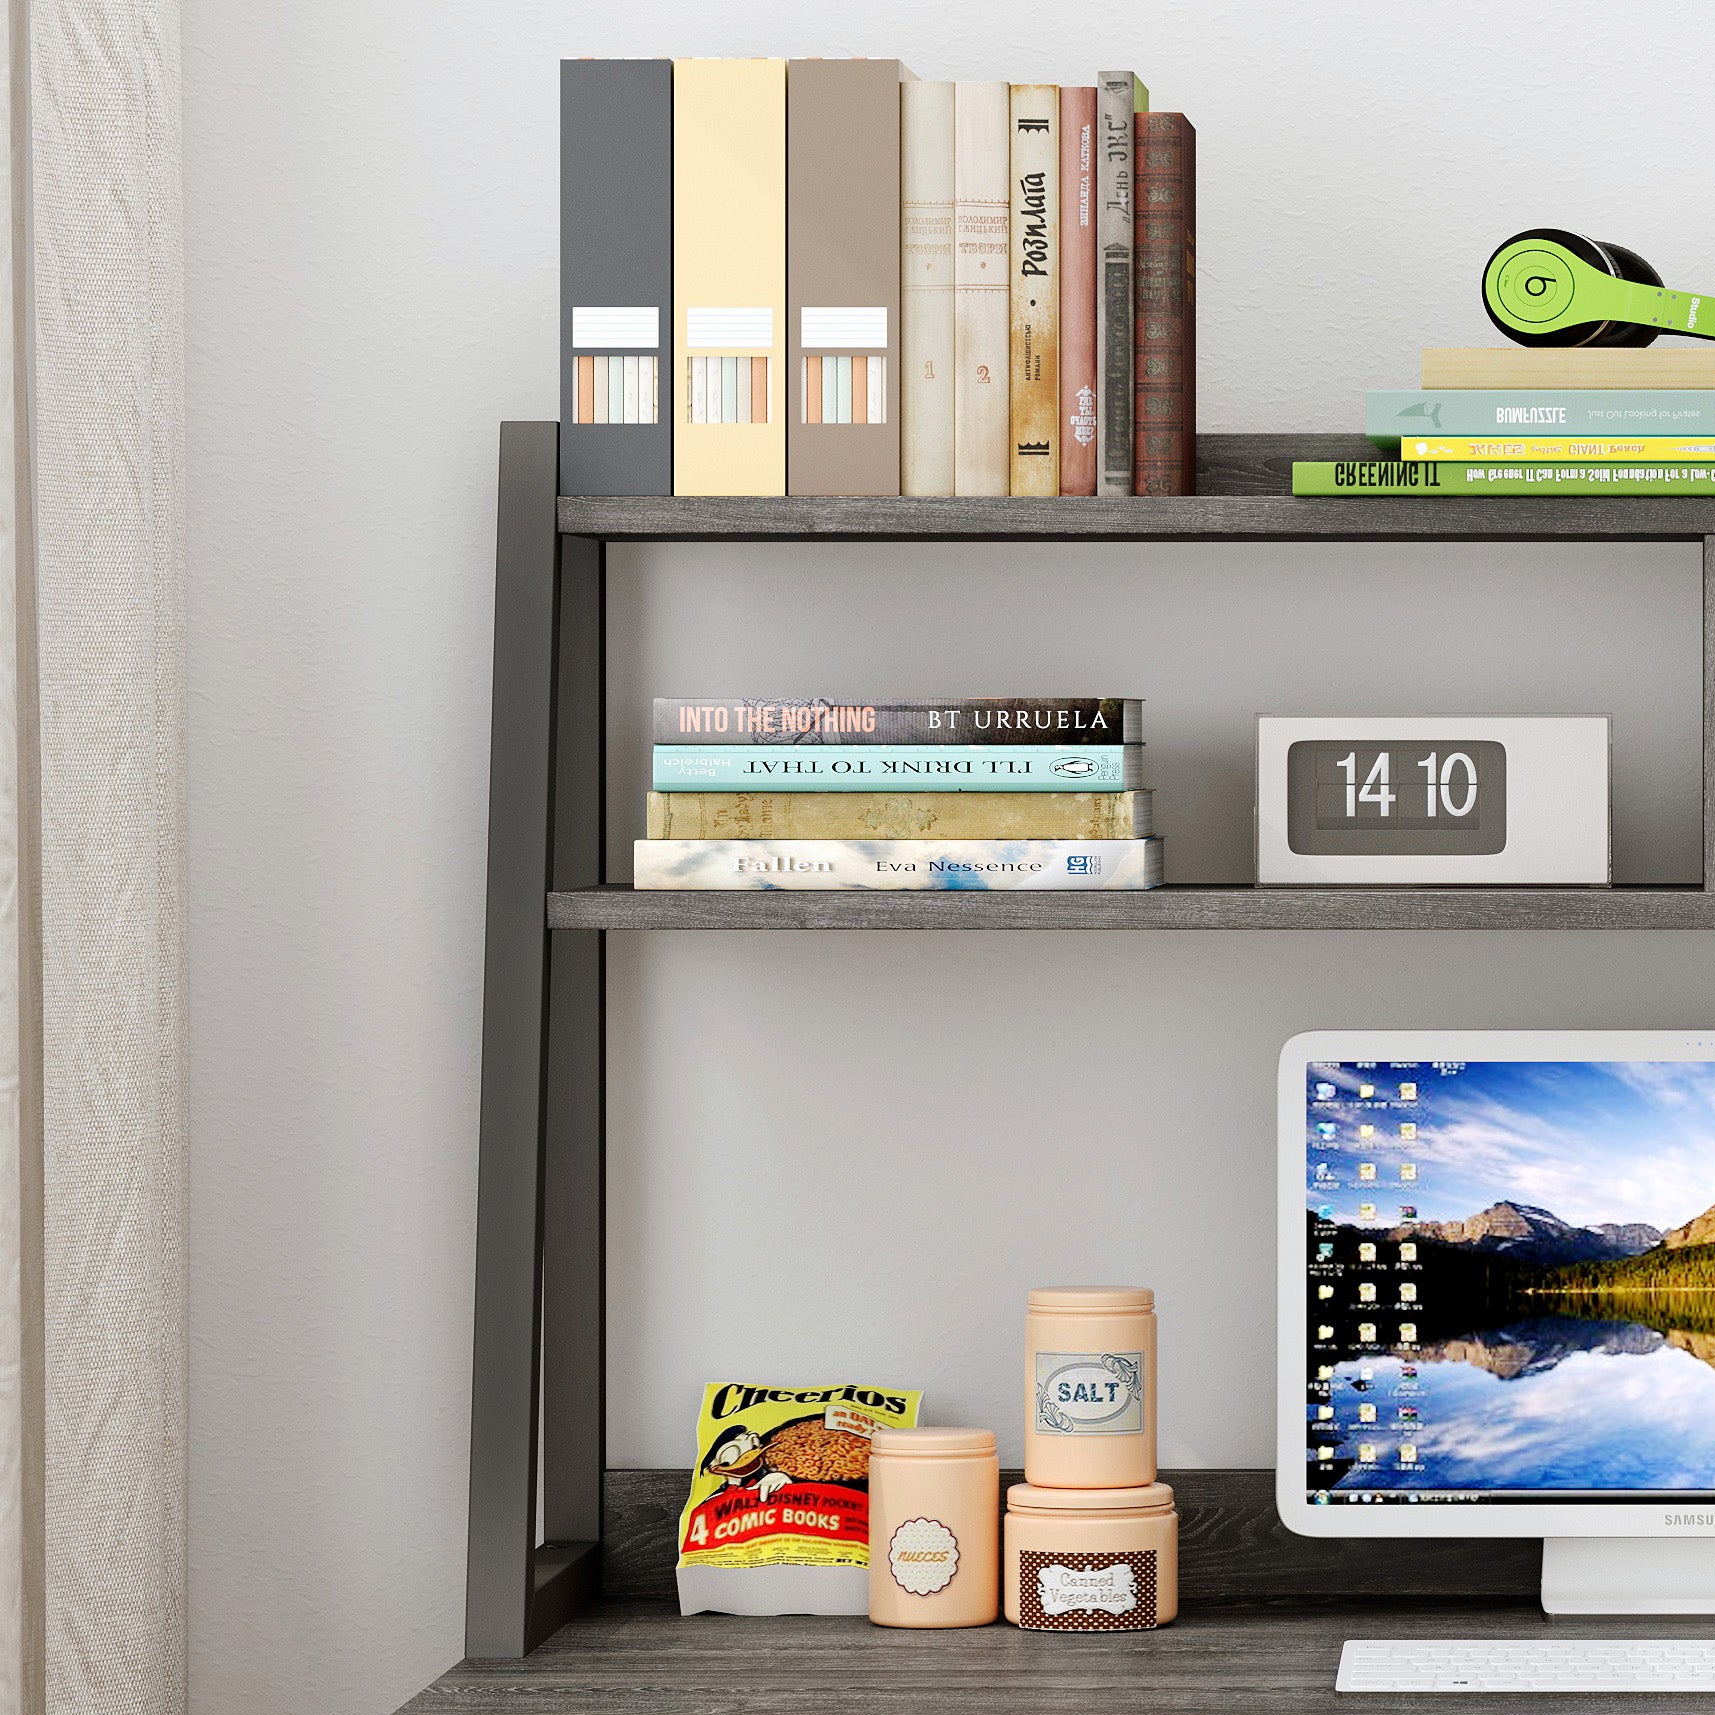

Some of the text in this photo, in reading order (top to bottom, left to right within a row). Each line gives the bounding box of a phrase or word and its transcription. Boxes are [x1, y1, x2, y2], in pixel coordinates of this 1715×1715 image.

[1080, 124, 1091, 227] ЗИНАИДА КАТКОВА
[958, 242, 1008, 254] ТВОРИ
[1686, 296, 1701, 329] Studio
[924, 360, 935, 379] 1
[976, 365, 991, 384] 2
[678, 706, 876, 733] INTO THE NOTHING
[927, 709, 1109, 730] BT URRUELA
[662, 756, 733, 767] Halbreich
[742, 760, 823, 776] THAT
[830, 760, 870, 776] TO
[878, 760, 973, 776] DRINK
[678, 766, 717, 778] Betty
[1335, 751, 1479, 818] 14 10
[731, 855, 833, 873] Fallen
[876, 860, 1043, 874] Eva Nessence
[1067, 857, 1086, 873] HG
[1057, 1381, 1120, 1403] SALT
[710, 1383, 907, 1420] Cheerios
[767, 1492, 820, 1508] DISNEY
[689, 1513, 710, 1546] 4
[713, 1508, 777, 1540] COMIC
[782, 1508, 841, 1532] BOOKS
[1060, 1572, 1115, 1588] Canned
[1050, 1588, 1127, 1607] Vegetables
